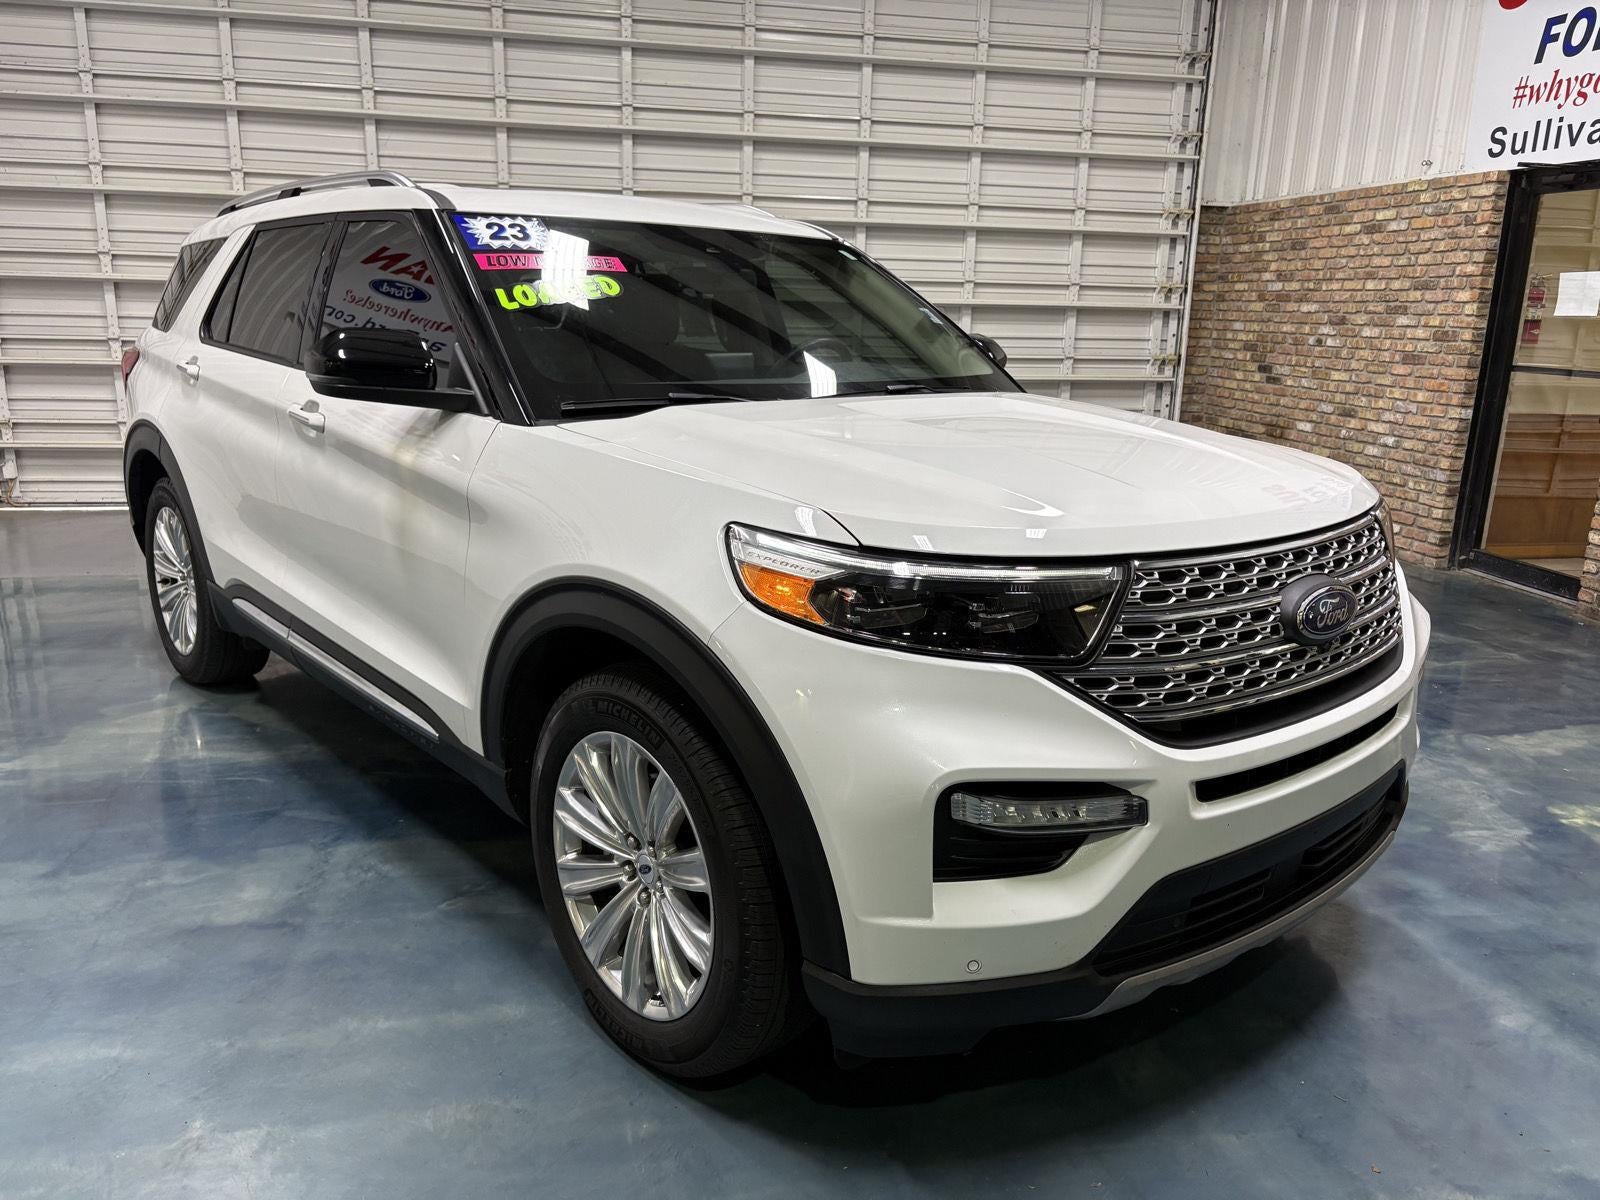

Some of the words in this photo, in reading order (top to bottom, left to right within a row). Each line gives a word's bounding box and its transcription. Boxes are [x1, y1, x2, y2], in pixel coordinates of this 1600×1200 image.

[1534, 6, 1600, 65] FO
[1487, 116, 1600, 159] Sulliva
[485, 222, 533, 242] 23
[487, 255, 527, 267] LOW
[494, 275, 622, 310] LOED
[747, 551, 820, 575] EXPLORER
[1317, 596, 1349, 628] Ford
[596, 700, 663, 749] MICHELIN
